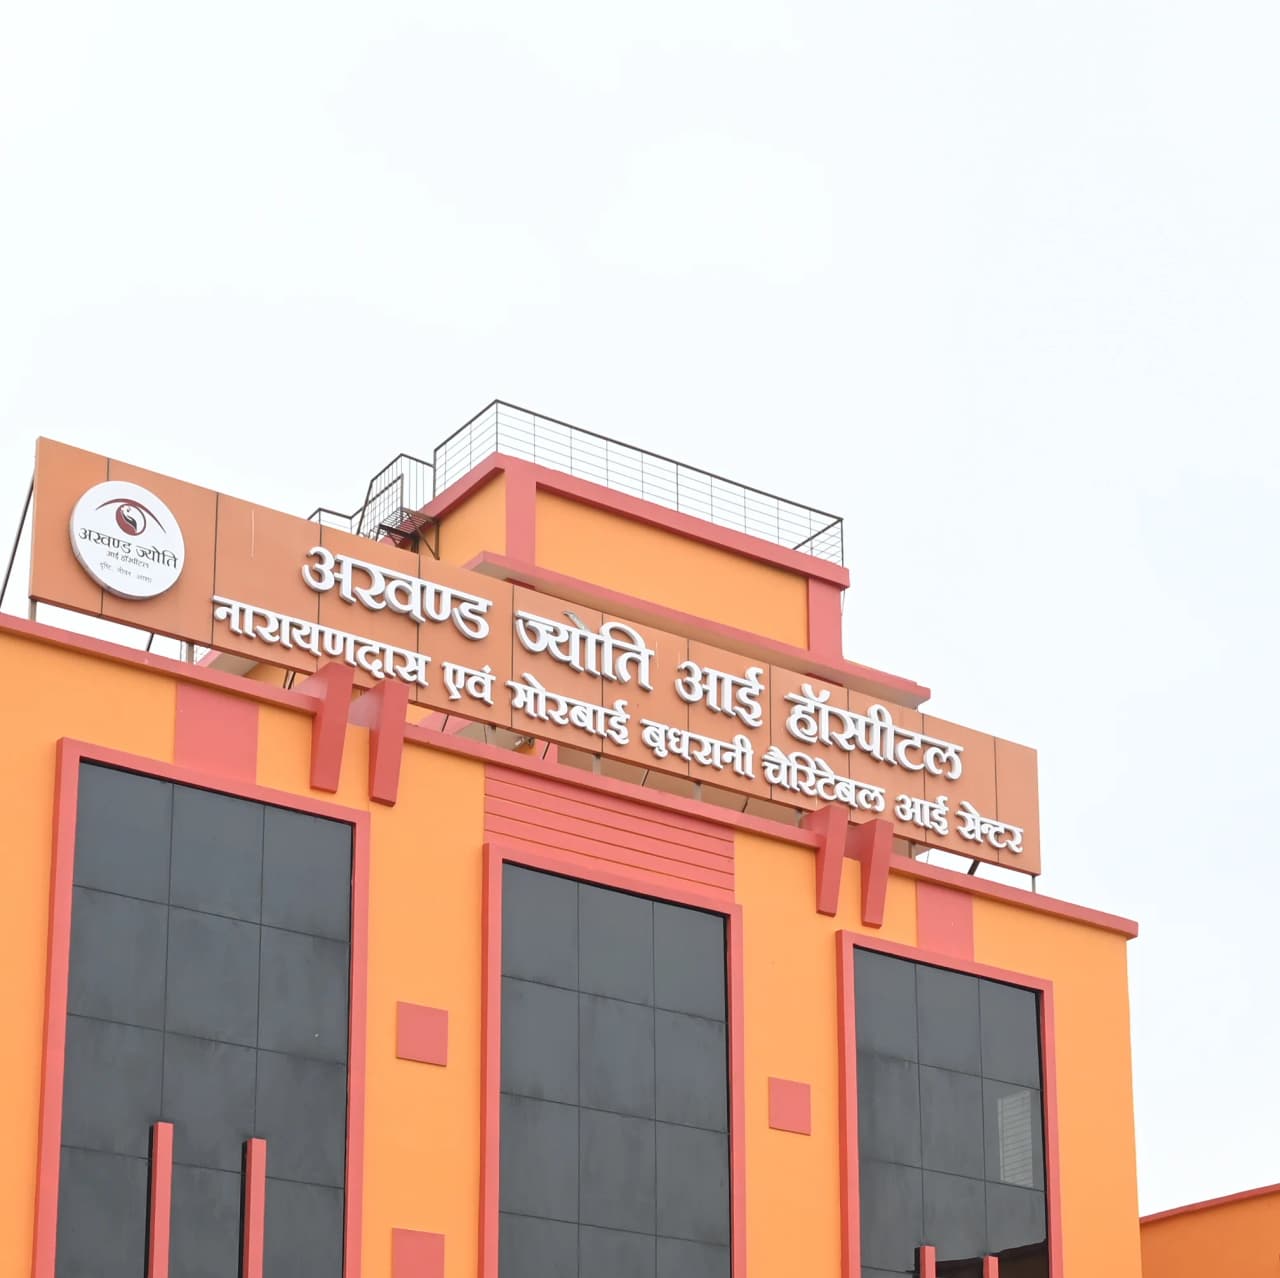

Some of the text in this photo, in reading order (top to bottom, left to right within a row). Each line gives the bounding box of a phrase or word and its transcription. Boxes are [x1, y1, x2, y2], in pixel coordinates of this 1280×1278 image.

[79, 528, 178, 568] अखण्ड ज्योति
[303, 545, 964, 780] अखण्ड ज्योति आई हॉस्पीटल
[211, 594, 1025, 854] नारायणदास एवं मोरबाई बुधरानी चैरिटेबल आई सेन्टर
